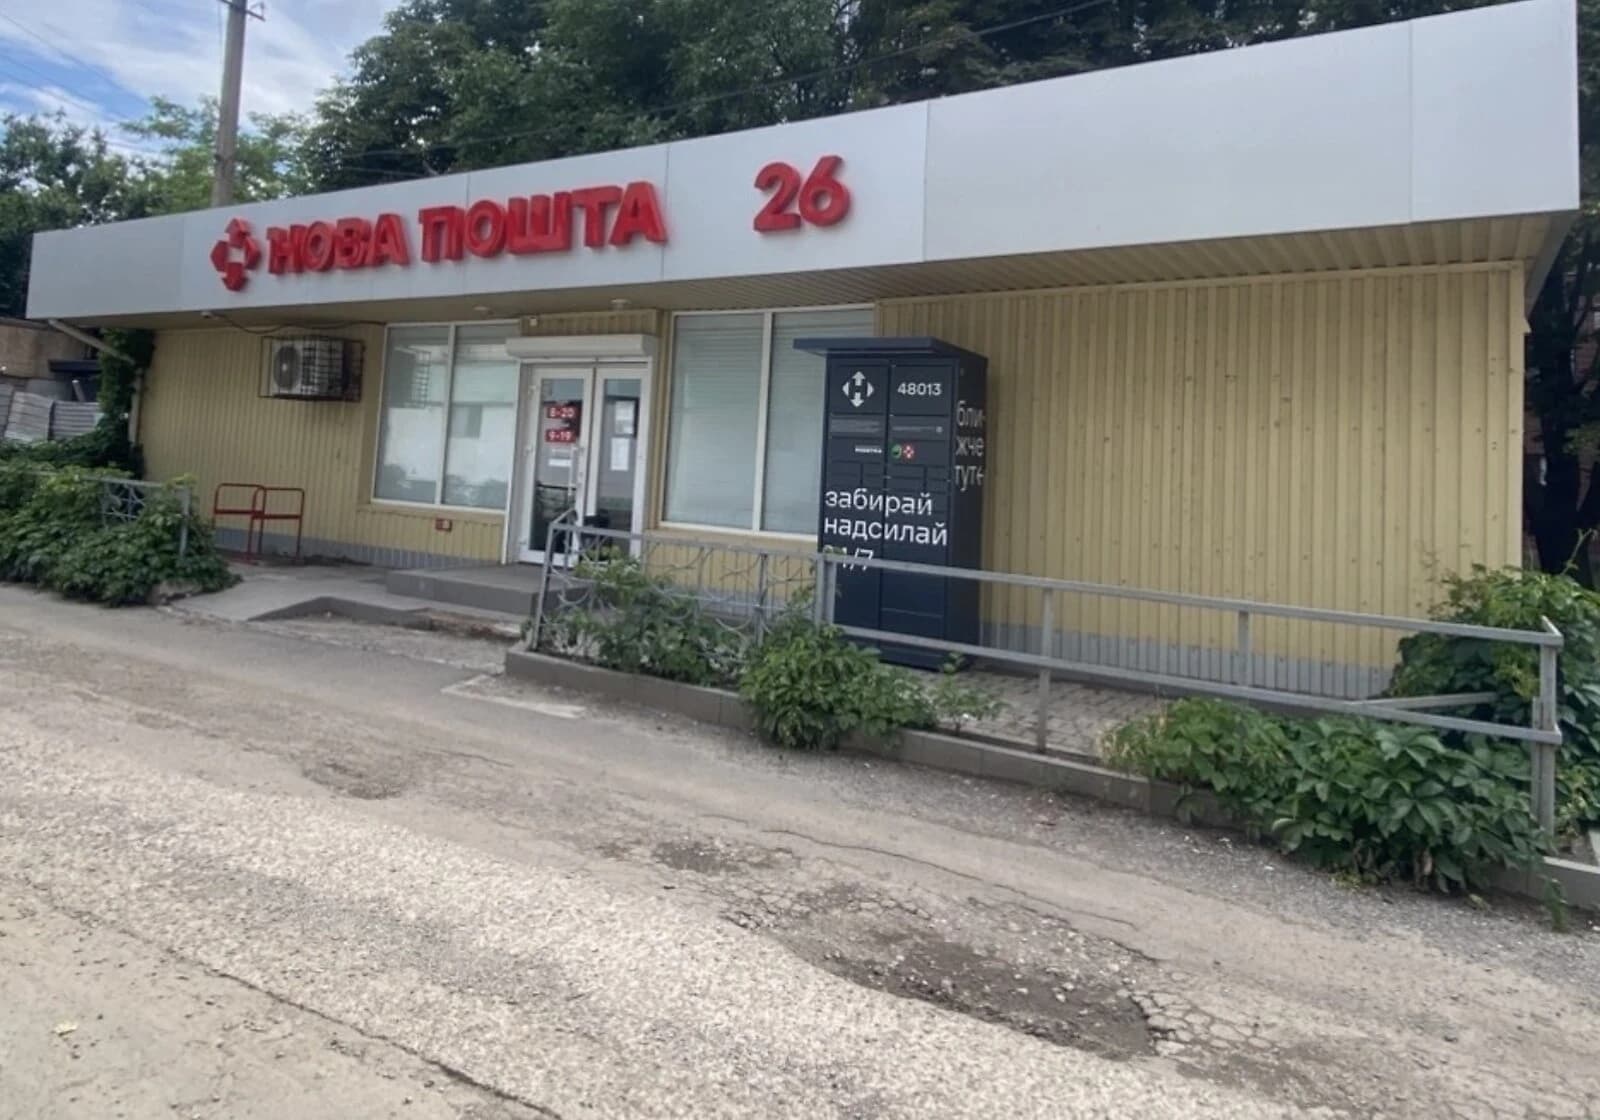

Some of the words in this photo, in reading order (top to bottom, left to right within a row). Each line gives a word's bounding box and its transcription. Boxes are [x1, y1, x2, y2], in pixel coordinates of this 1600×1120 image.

[753, 155, 851, 232] 26
[267, 213, 410, 275] НОВА
[420, 181, 667, 263] ПОШТА
[897, 382, 942, 397] 48013
[825, 488, 932, 517] забирай
[824, 517, 948, 546] надсилай
